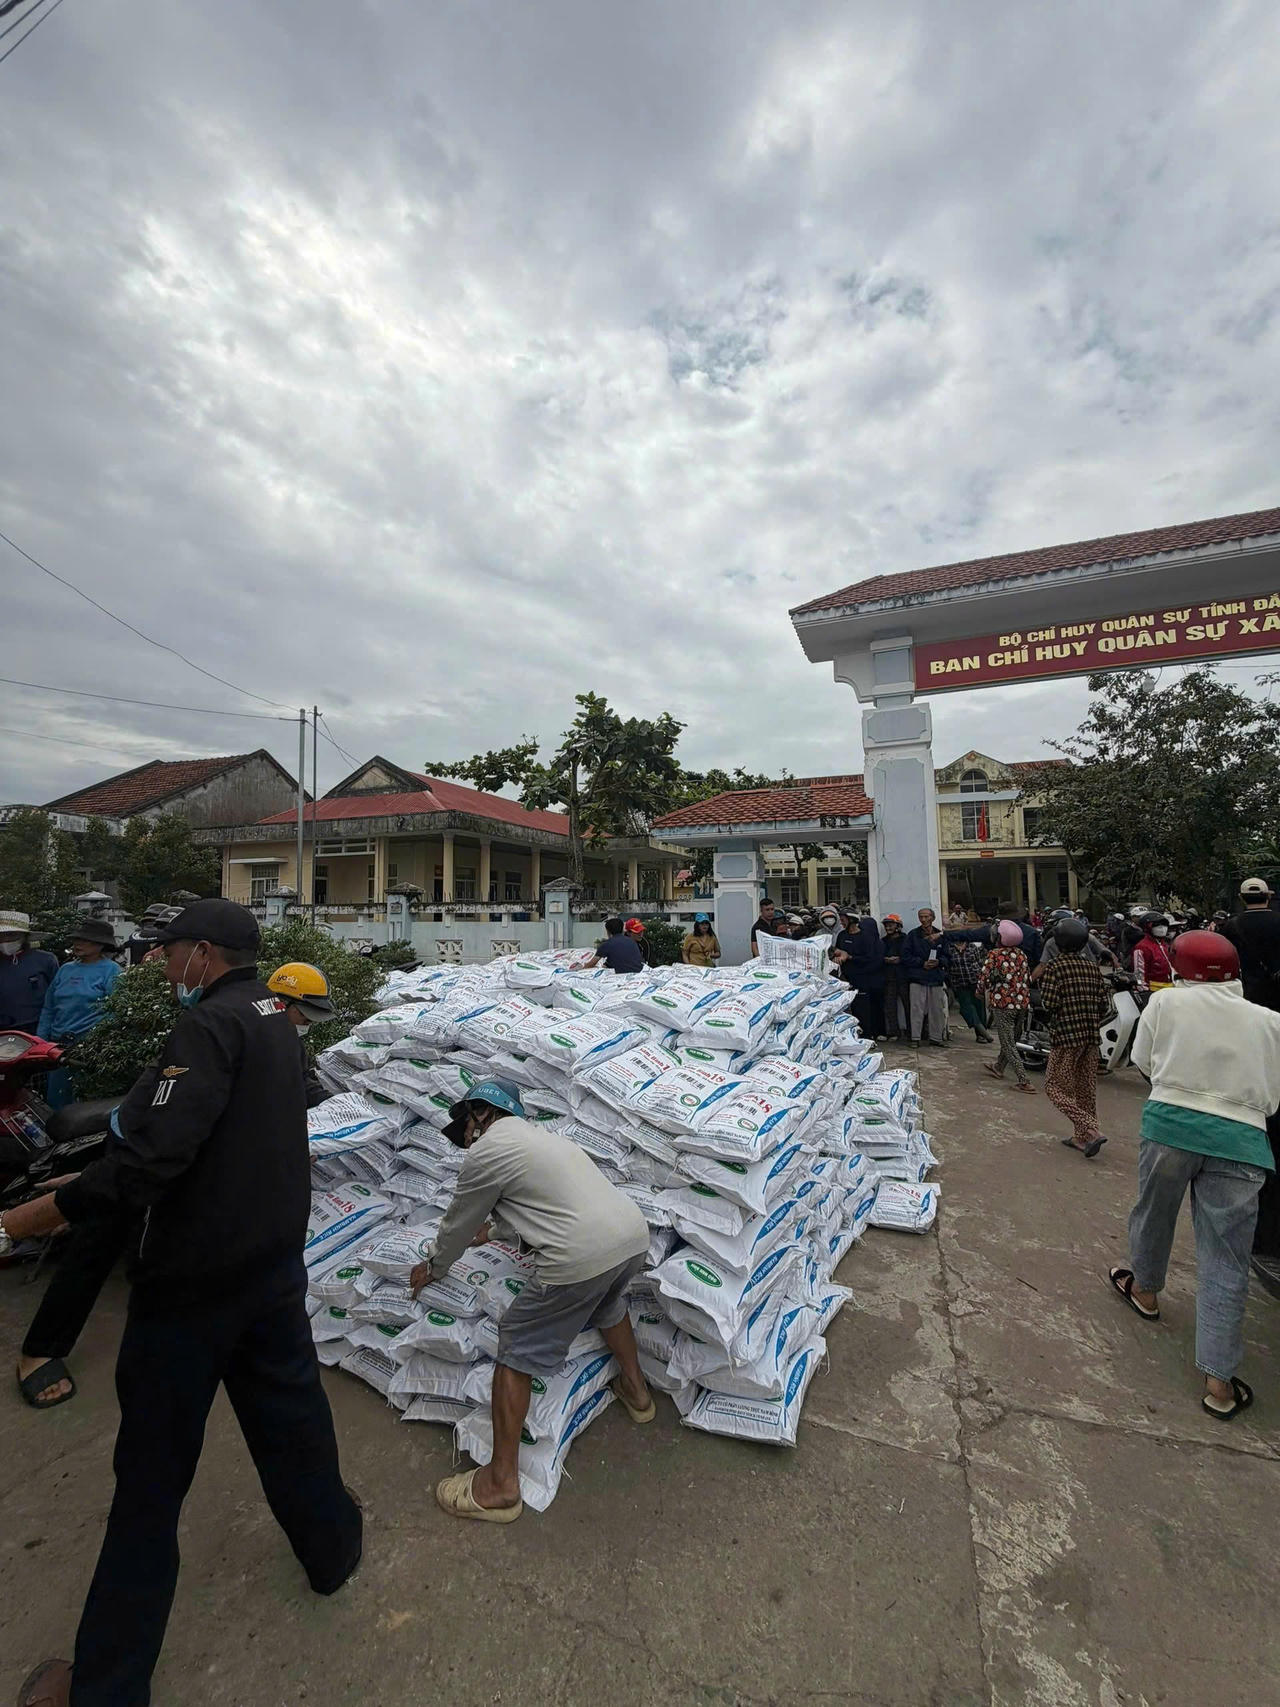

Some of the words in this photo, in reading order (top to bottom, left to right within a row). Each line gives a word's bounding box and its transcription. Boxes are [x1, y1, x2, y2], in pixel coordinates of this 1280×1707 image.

[999, 631, 1022, 648] BỘ
[1027, 626, 1056, 646] CHỈ
[1061, 622, 1096, 638] HUY
[1101, 614, 1155, 633] QUÂN
[1163, 607, 1191, 625] SỰ
[930, 656, 980, 675] BAN
[987, 644, 1029, 668] CHỈ
[1036, 640, 1088, 661] HUY
[1097, 628, 1177, 654] QUÂN
[1186, 619, 1229, 642] SỰ
[1238, 612, 1280, 635] XÃ
[710, 1071, 726, 1084] 18
[755, 1096, 774, 1115] 18
[339, 1198, 356, 1215] 18
[318, 1228, 333, 1241] RICE
